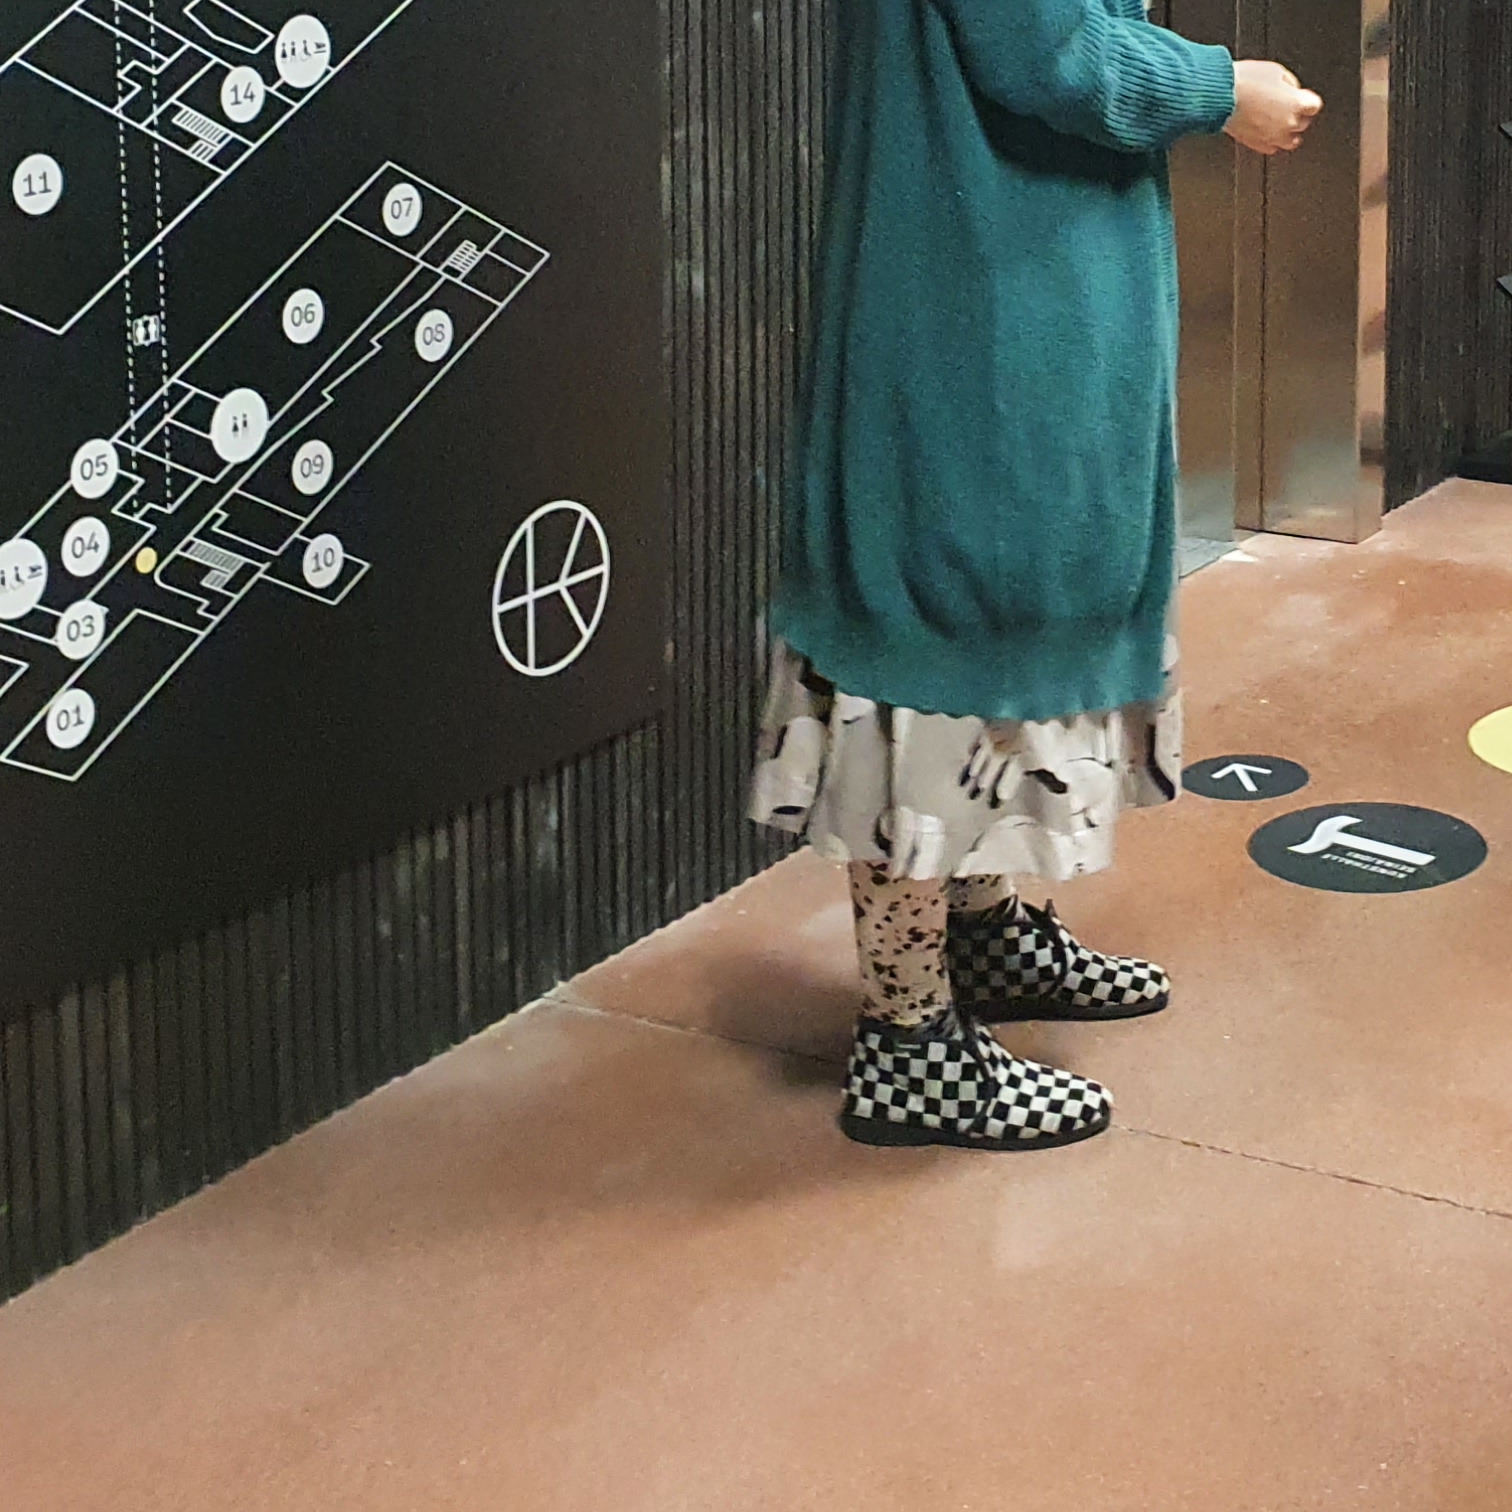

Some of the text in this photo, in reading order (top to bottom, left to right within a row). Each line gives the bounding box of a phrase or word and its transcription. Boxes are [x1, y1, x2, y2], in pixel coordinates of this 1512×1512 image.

[230, 83, 255, 106] 14
[23, 172, 52, 197] 11
[391, 198, 413, 219] 07
[291, 303, 315, 326] 06
[422, 324, 445, 345] 08
[80, 455, 108, 481] 05
[300, 454, 324, 478] 09
[72, 532, 100, 559] 04
[312, 548, 335, 573] 10
[67, 615, 95, 642] 03
[57, 705, 85, 731] 01
